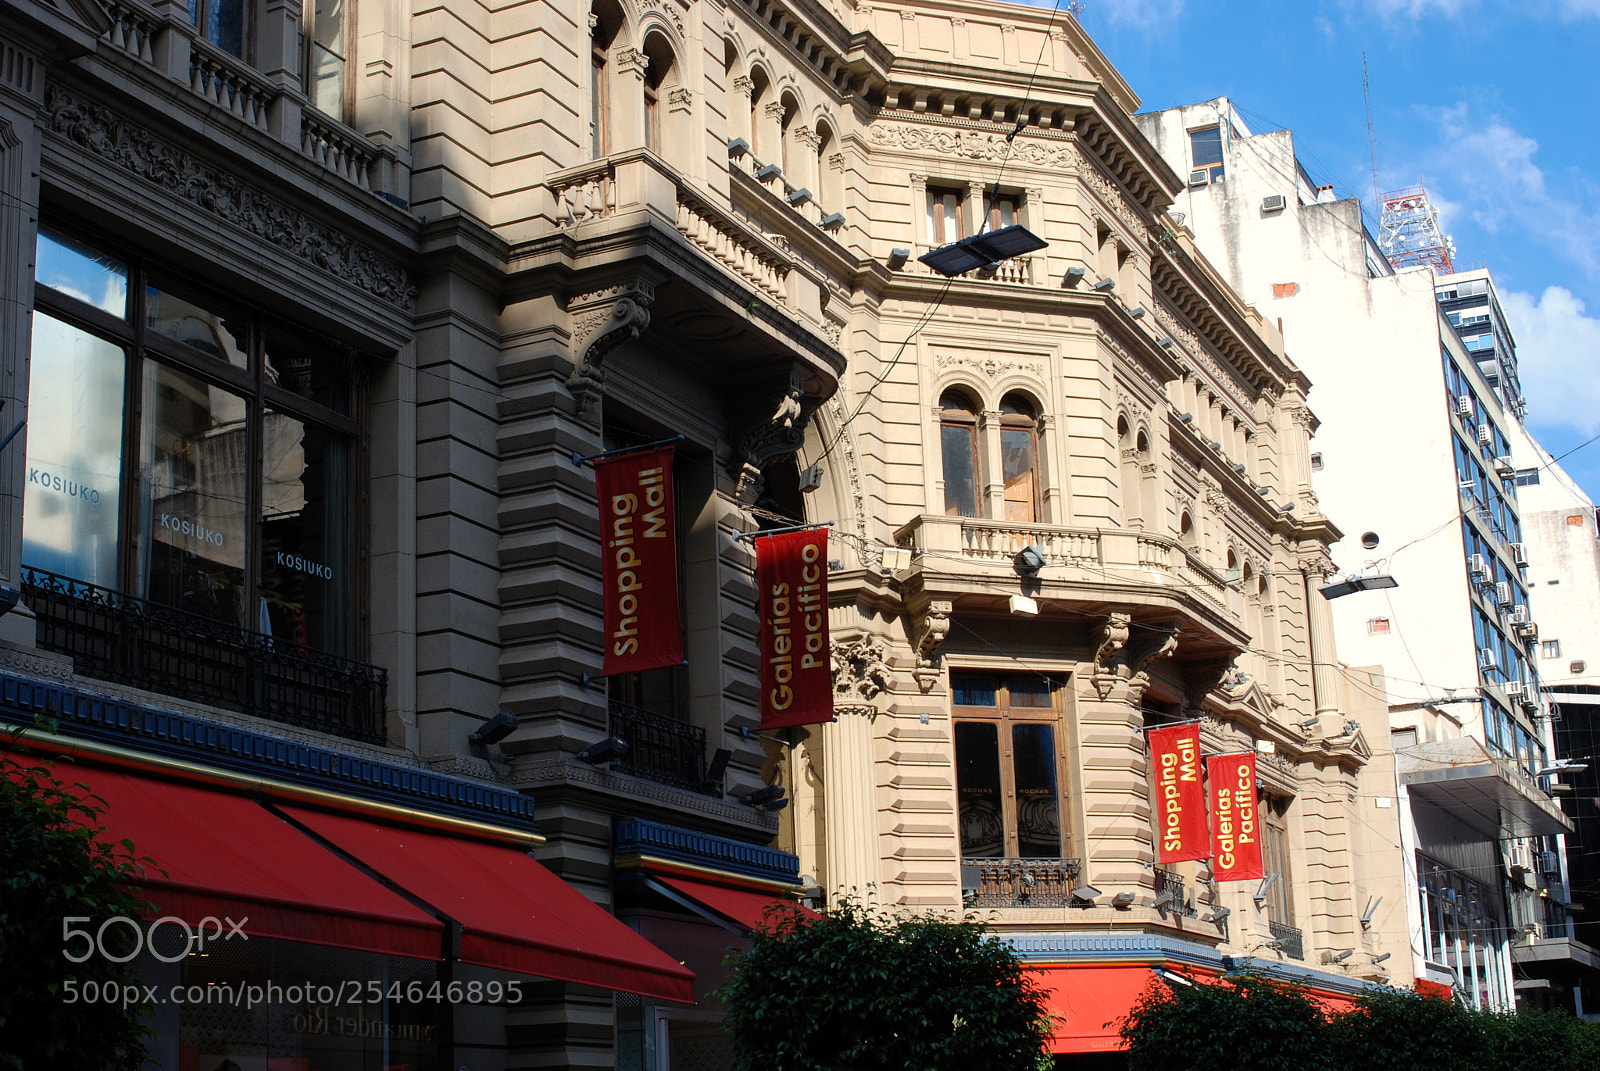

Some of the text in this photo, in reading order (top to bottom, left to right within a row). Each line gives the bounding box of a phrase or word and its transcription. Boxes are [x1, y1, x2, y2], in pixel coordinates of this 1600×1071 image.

[28, 467, 100, 504] KOSIUKO
[638, 466, 667, 538] Mall
[161, 513, 224, 547] KOSIUKO
[277, 552, 332, 580] KOSIUKO
[609, 493, 643, 657] Shopping
[797, 544, 824, 670] Pacífico
[767, 582, 794, 711] Galerías
[1177, 737, 1198, 782] Mall
[1160, 752, 1183, 852] Shopping
[1215, 788, 1236, 870] Galerías
[1235, 764, 1255, 844] Pacífico
